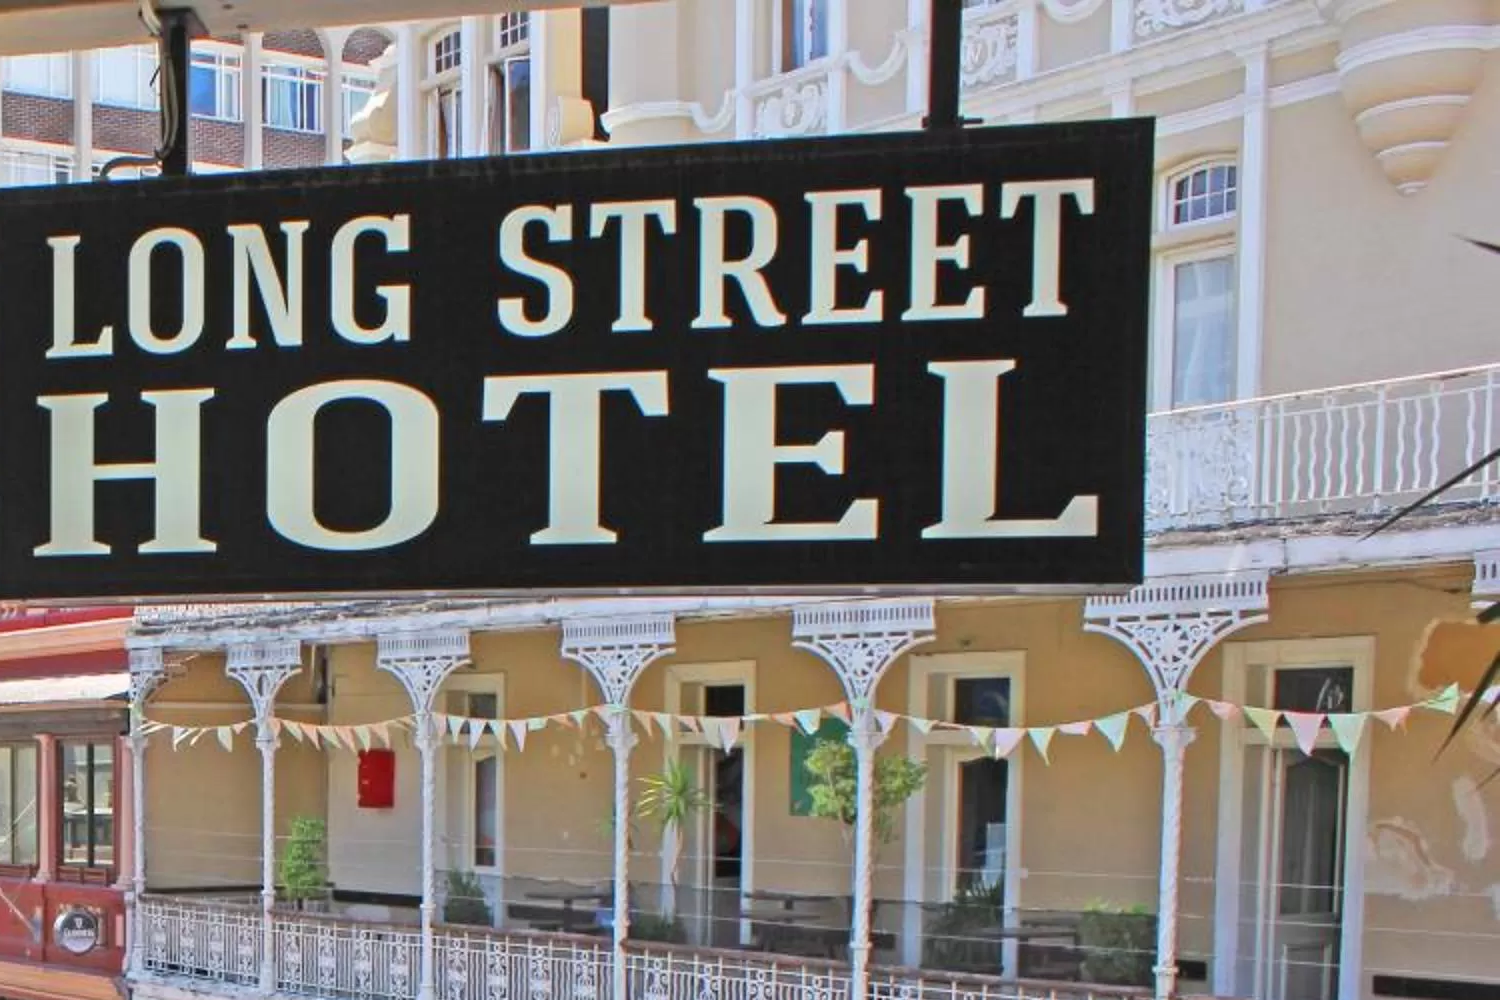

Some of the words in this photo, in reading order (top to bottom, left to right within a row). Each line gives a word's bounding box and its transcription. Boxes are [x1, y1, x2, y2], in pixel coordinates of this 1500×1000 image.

[45, 213, 411, 359] LONG
[497, 178, 1095, 337] STREET
[33, 359, 1098, 557] HOTEL
